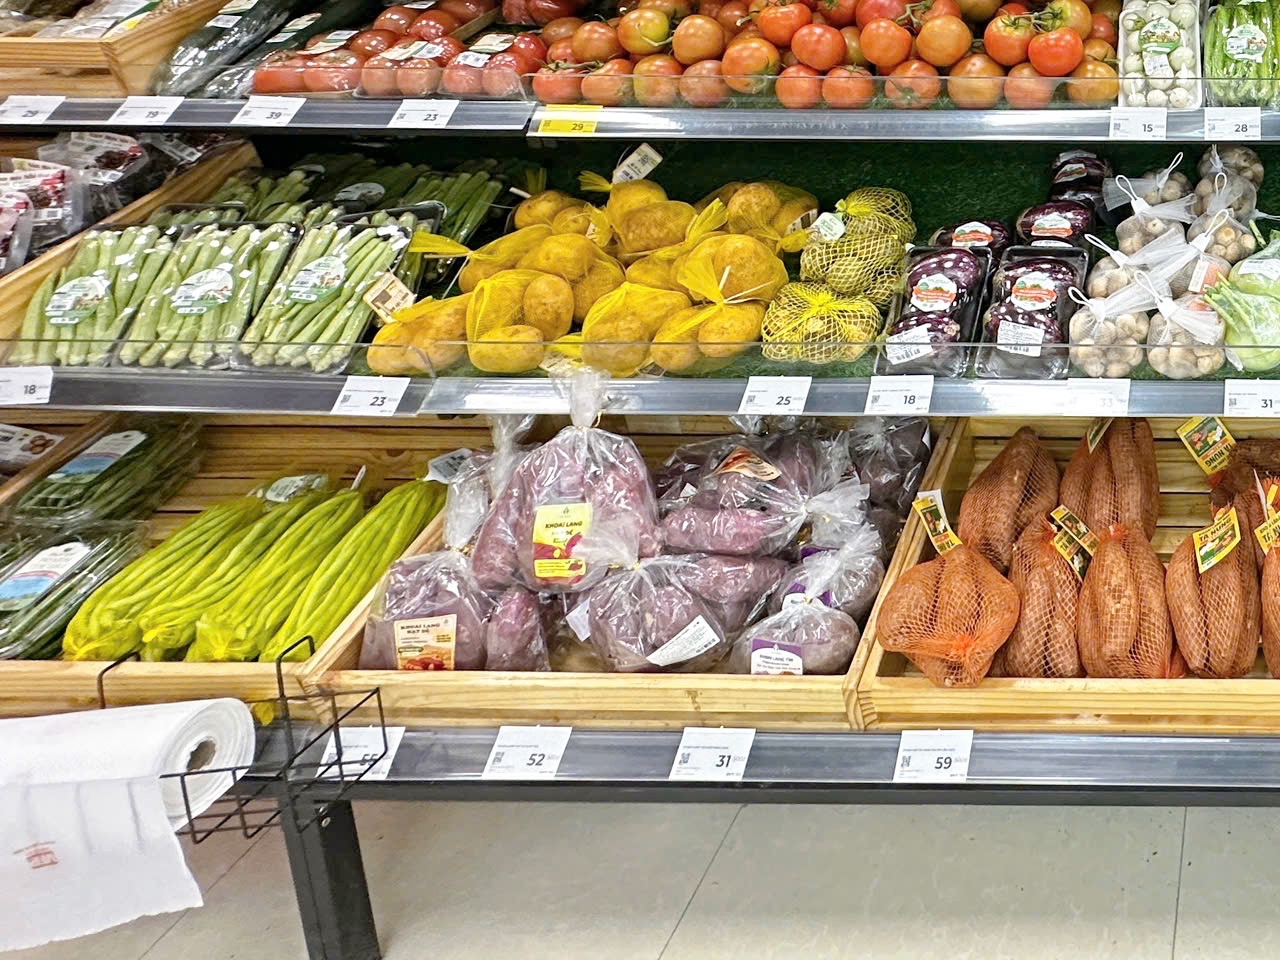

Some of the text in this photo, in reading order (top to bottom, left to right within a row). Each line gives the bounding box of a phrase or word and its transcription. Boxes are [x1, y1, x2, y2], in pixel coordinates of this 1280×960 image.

[265, 112, 282, 120] 39
[423, 114, 438, 122] 23
[570, 123, 584, 131] 29
[1142, 123, 1153, 132] 15
[1235, 124, 1248, 132] 28
[23, 384, 36, 394] 18
[370, 396, 386, 406] 23
[775, 396, 791, 405] 25
[903, 395, 915, 405] 18
[1260, 399, 1273, 408] 31
[1210, 517, 1232, 536] NUNG
[527, 753, 546, 767] 52
[715, 754, 731, 768] 31
[934, 756, 953, 770] 59
